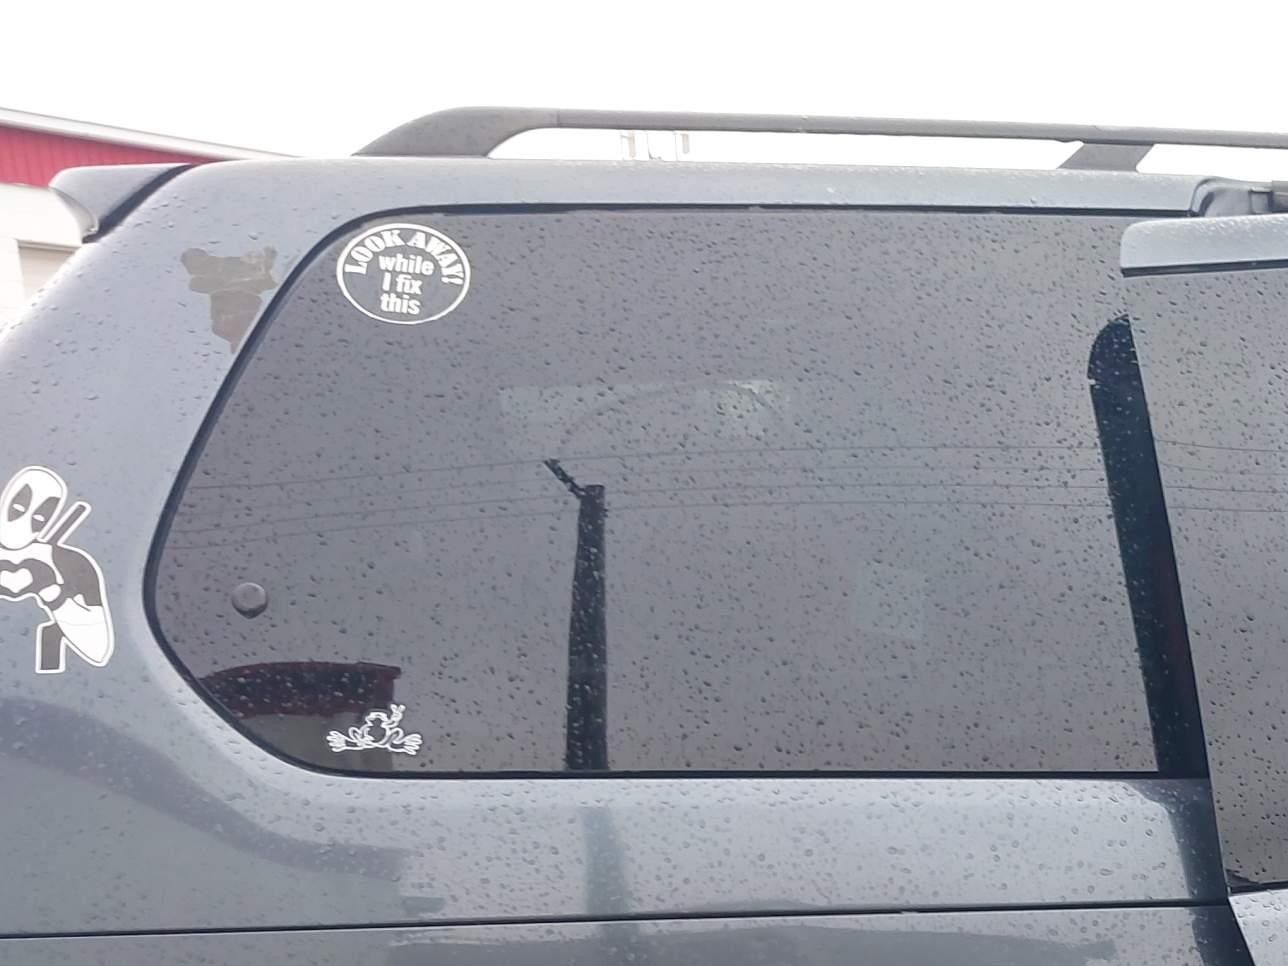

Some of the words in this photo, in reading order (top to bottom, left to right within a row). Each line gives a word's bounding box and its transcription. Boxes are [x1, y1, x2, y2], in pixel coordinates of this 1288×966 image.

[344, 229, 406, 275] LOOK
[406, 231, 465, 285] AWAY!
[378, 253, 435, 276] while
[382, 272, 392, 291] I
[395, 273, 423, 295] fix
[380, 293, 421, 315] this
